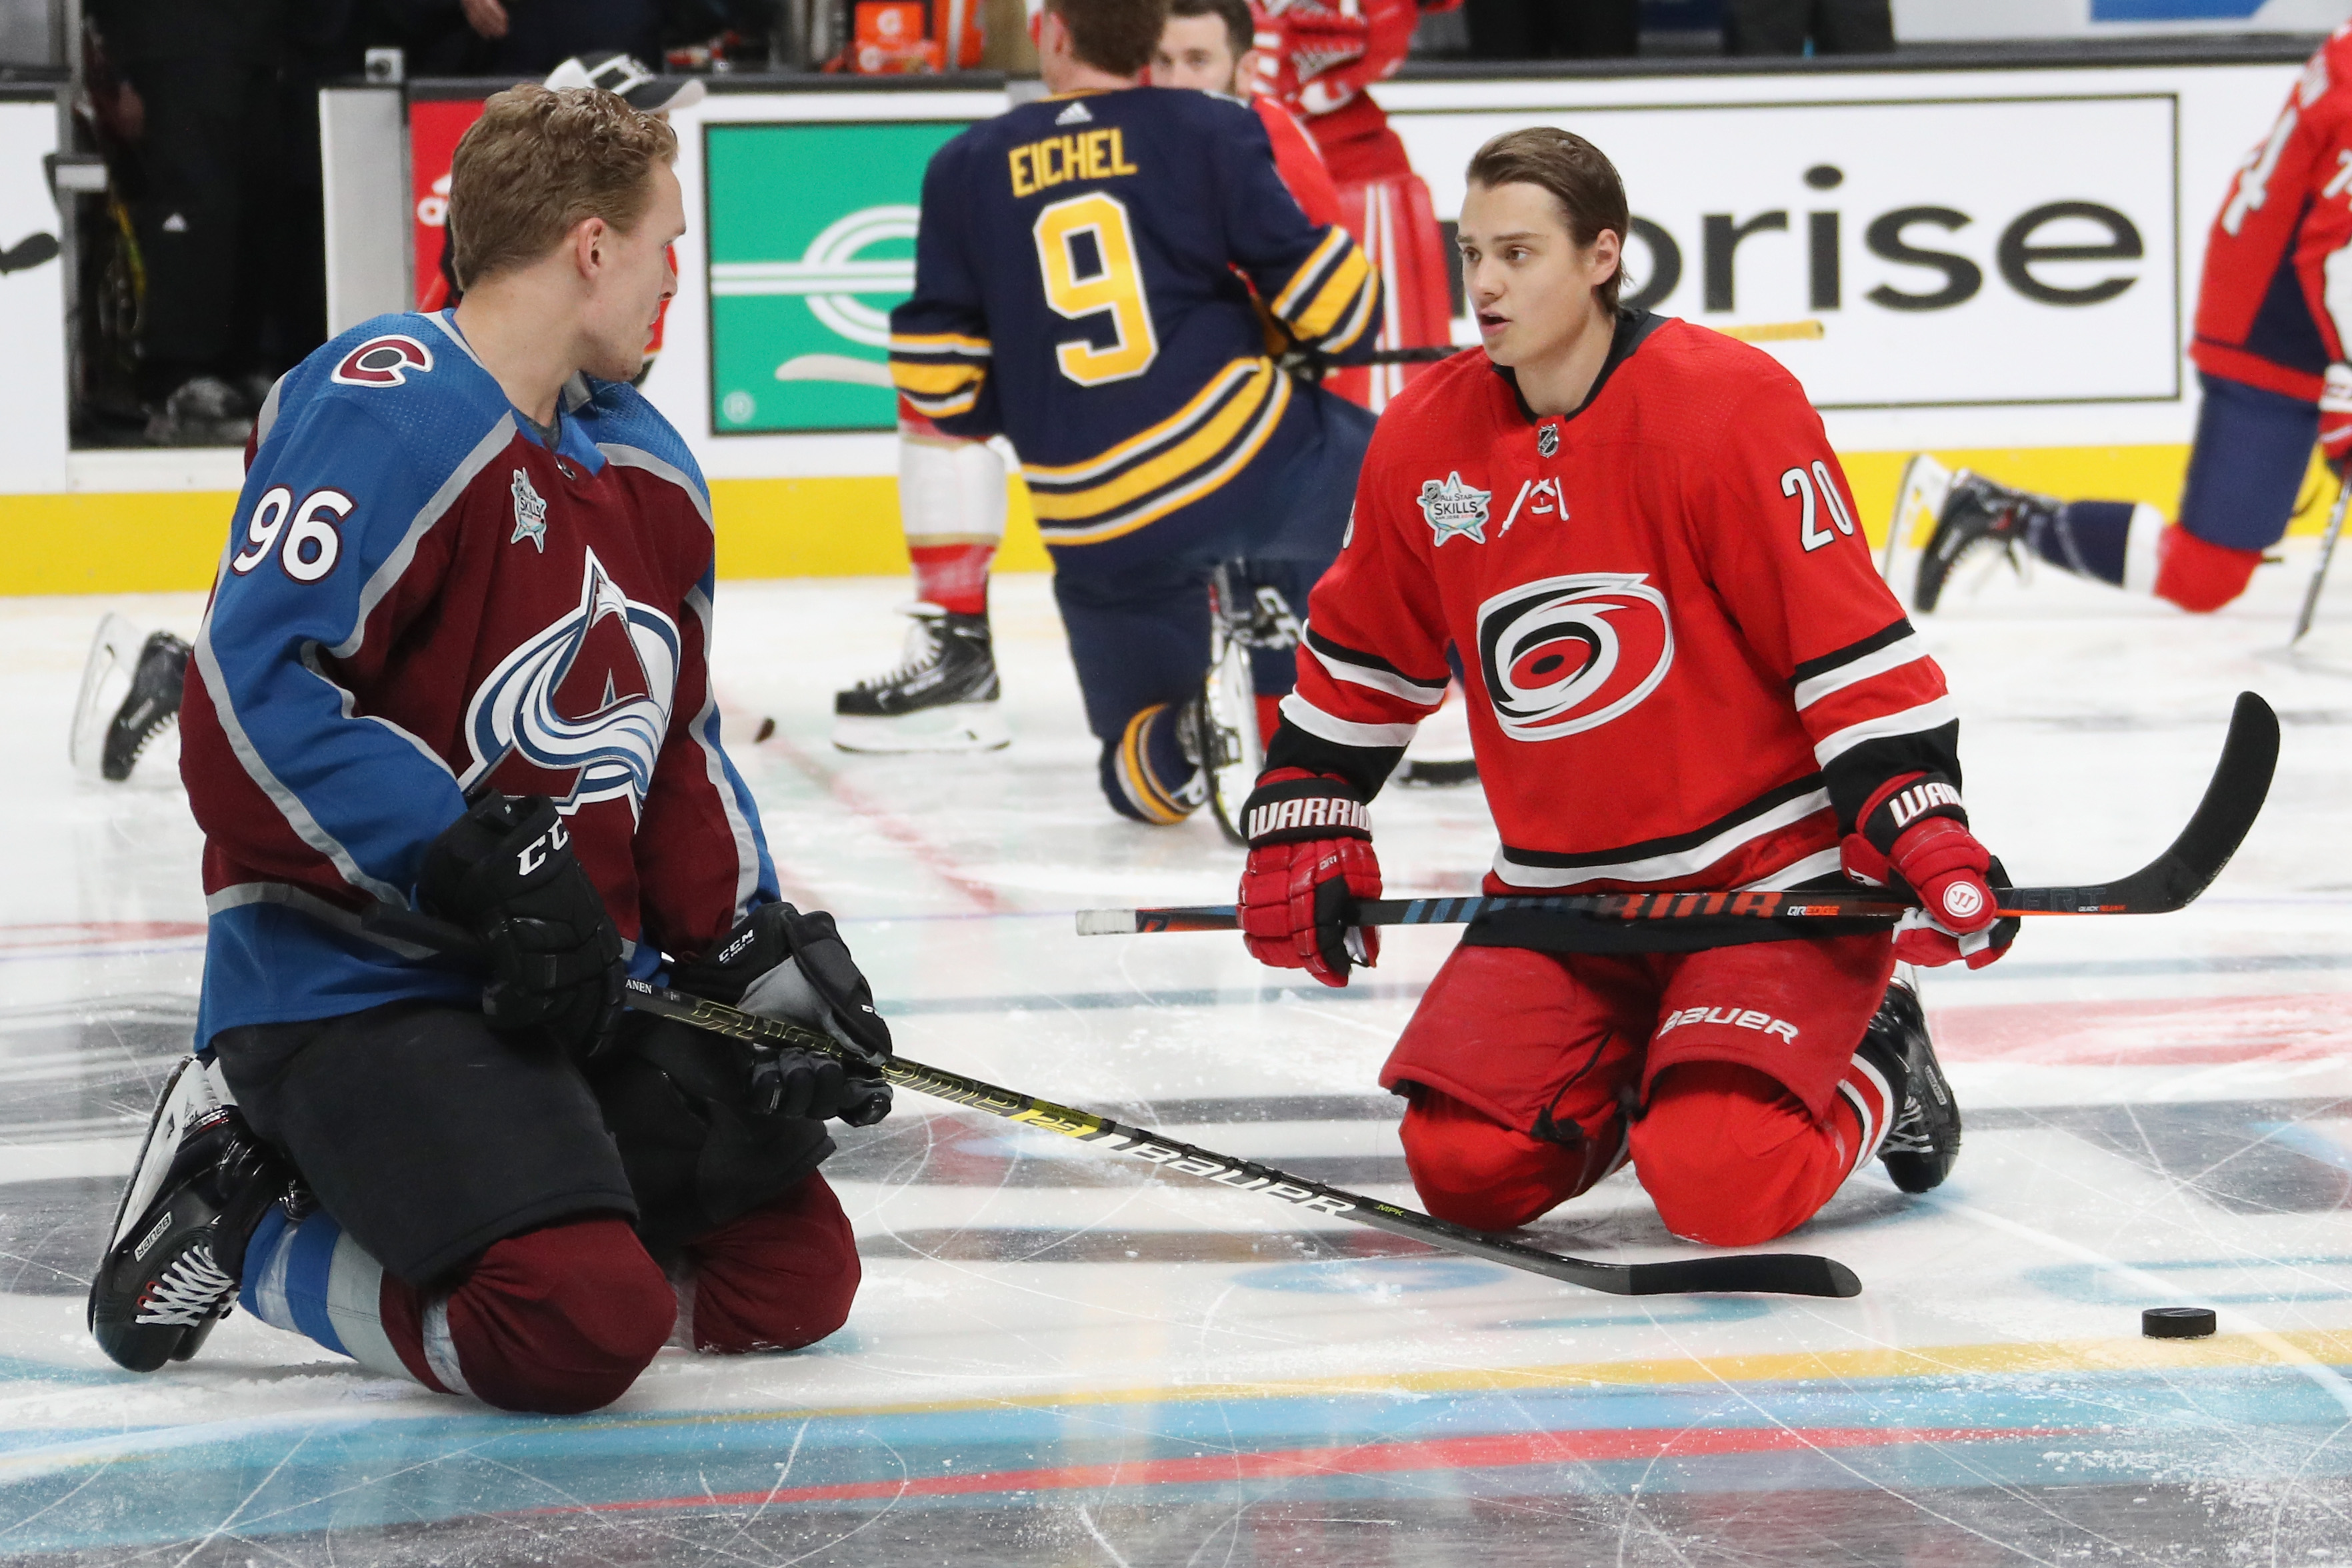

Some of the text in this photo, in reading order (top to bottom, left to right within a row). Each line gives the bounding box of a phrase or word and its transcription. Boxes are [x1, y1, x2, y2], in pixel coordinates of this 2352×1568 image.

[1009, 127, 1145, 198] EICHEL
[1033, 191, 1159, 387] 9
[1434, 501, 1477, 515] SKILLS
[1781, 460, 1855, 552] 20
[231, 484, 358, 585] 96
[1249, 798, 1373, 840] WARRIO
[517, 815, 569, 875] CC
[719, 929, 753, 962] CCM
[625, 978, 652, 994] ANEN
[1657, 1007, 1799, 1045] BAUER
[1128, 1141, 1357, 1216] BAUER
[136, 1215, 170, 1257] BAUER
